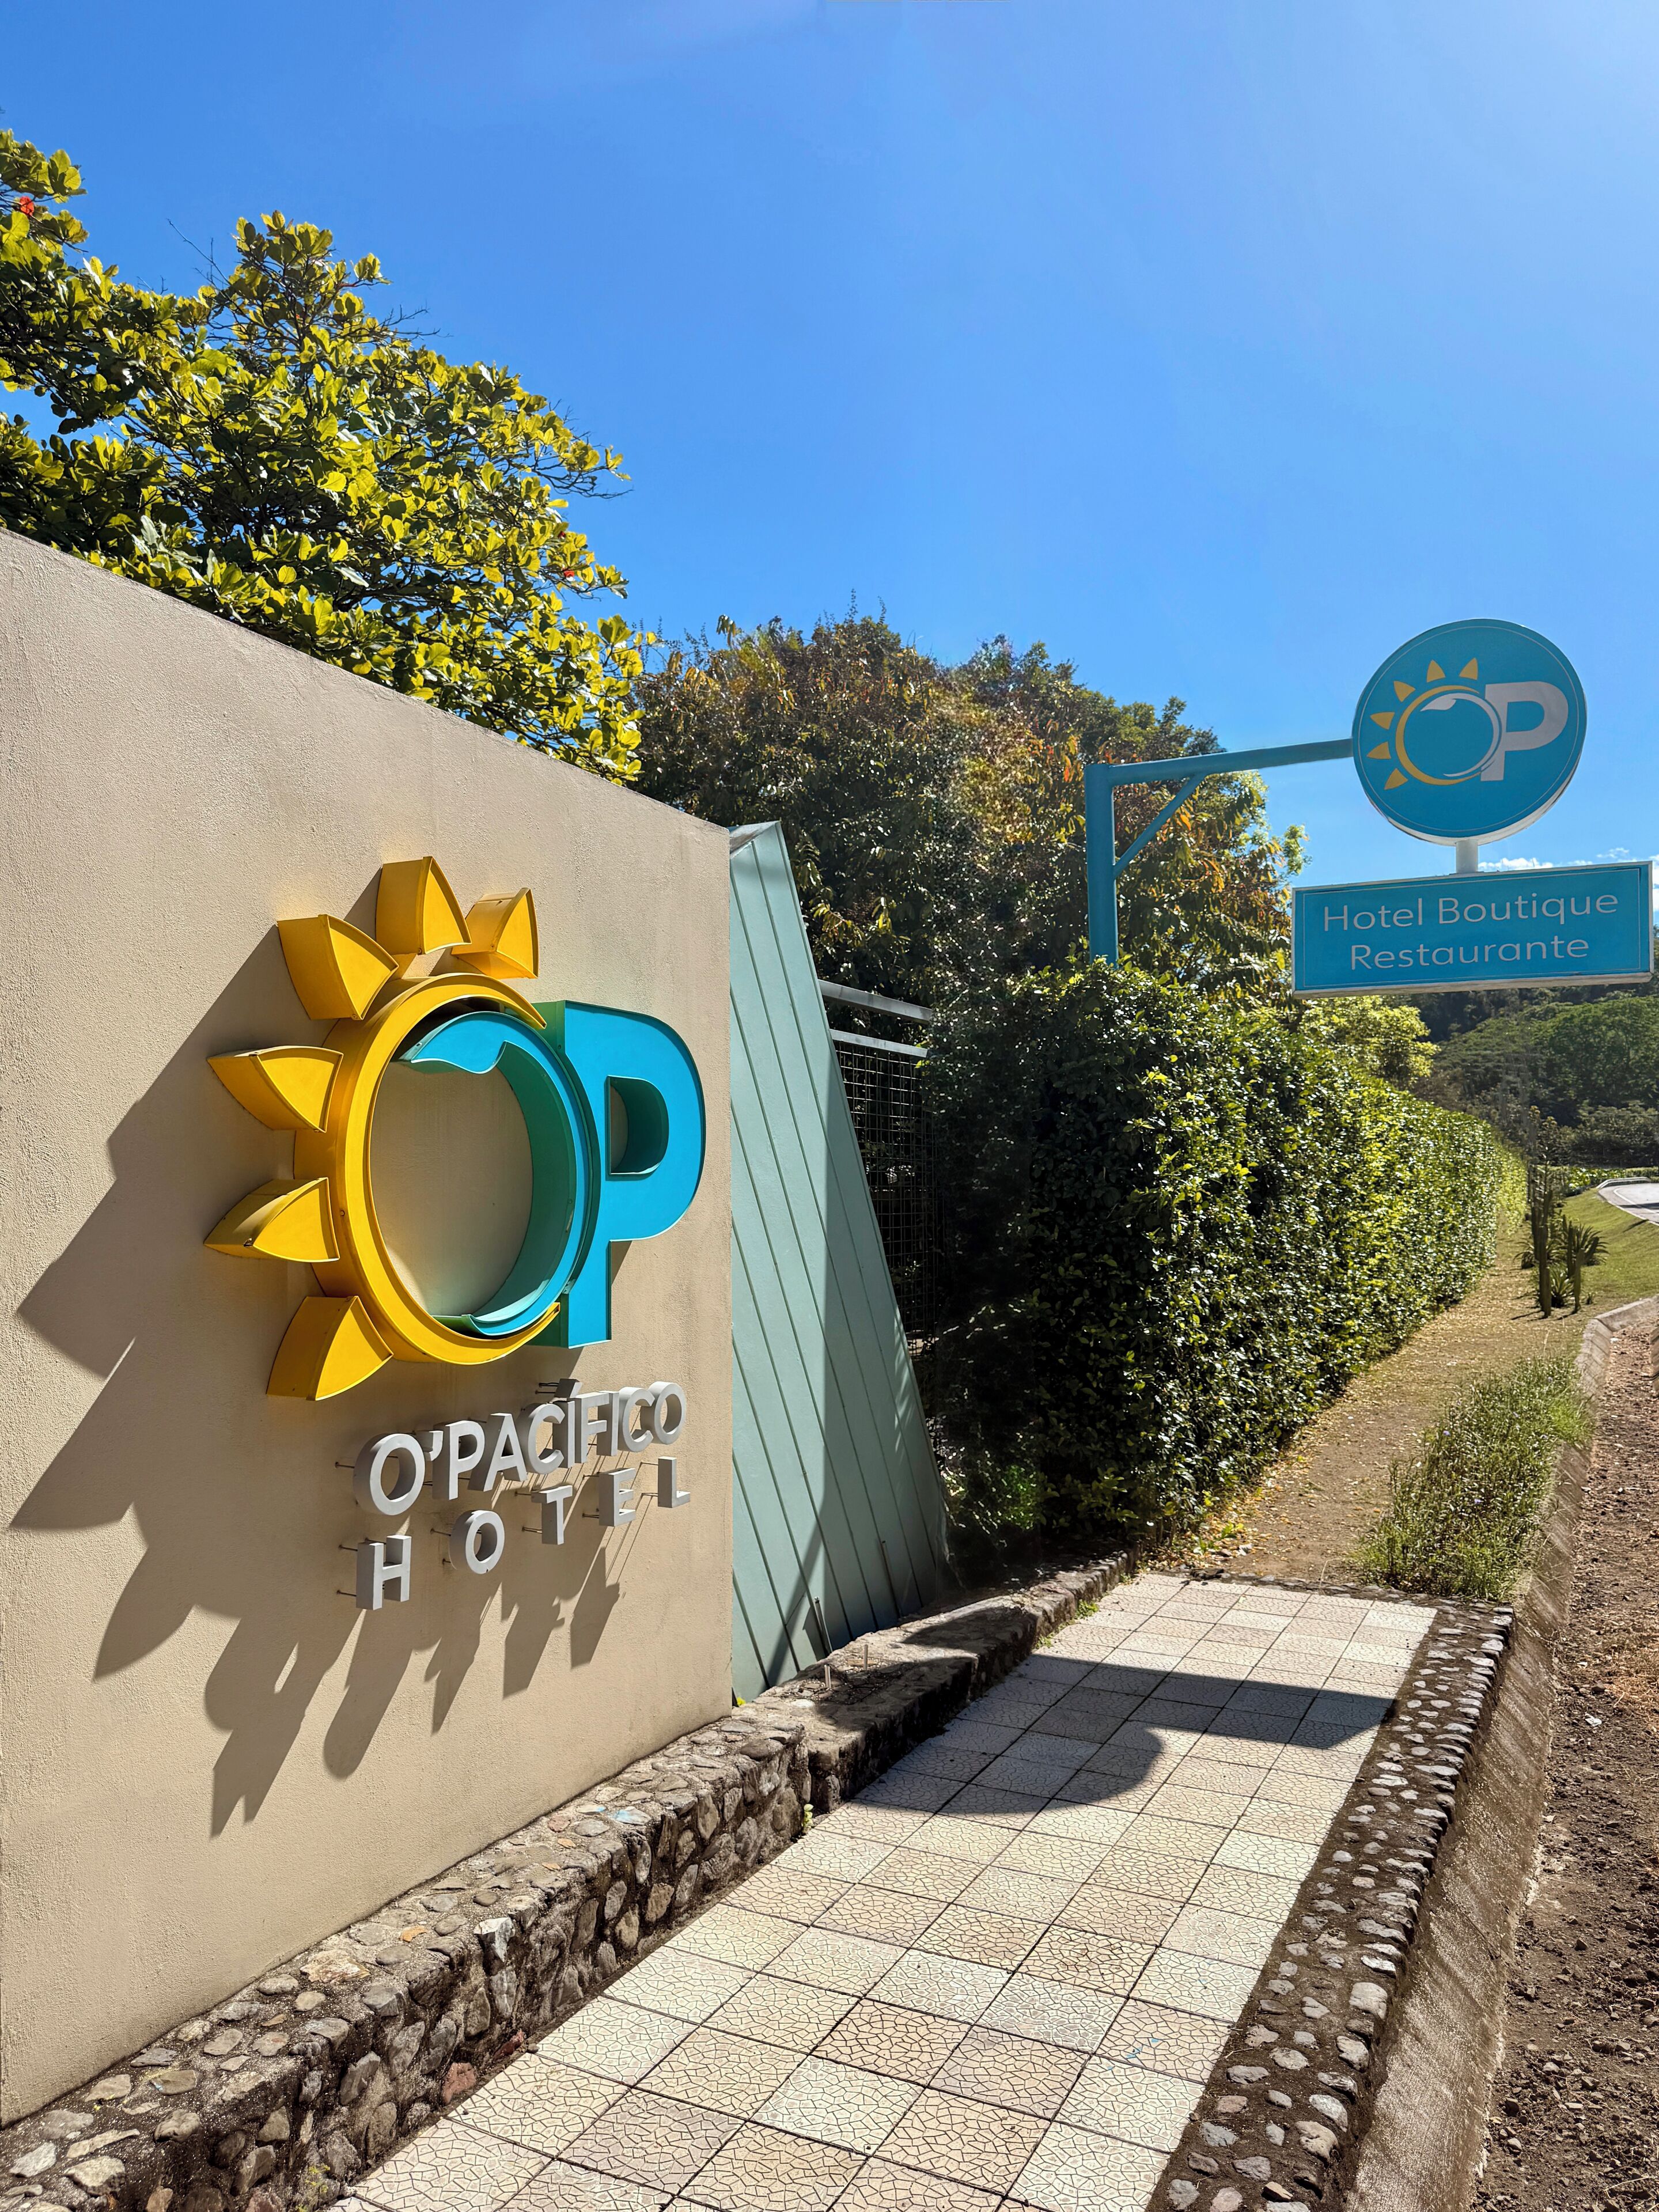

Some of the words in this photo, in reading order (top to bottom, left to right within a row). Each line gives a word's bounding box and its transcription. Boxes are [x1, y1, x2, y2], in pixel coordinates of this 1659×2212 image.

[1324, 898, 1423, 931] Hotel
[1438, 892, 1619, 925] Boutique
[1351, 935, 1589, 970] Restaurante
